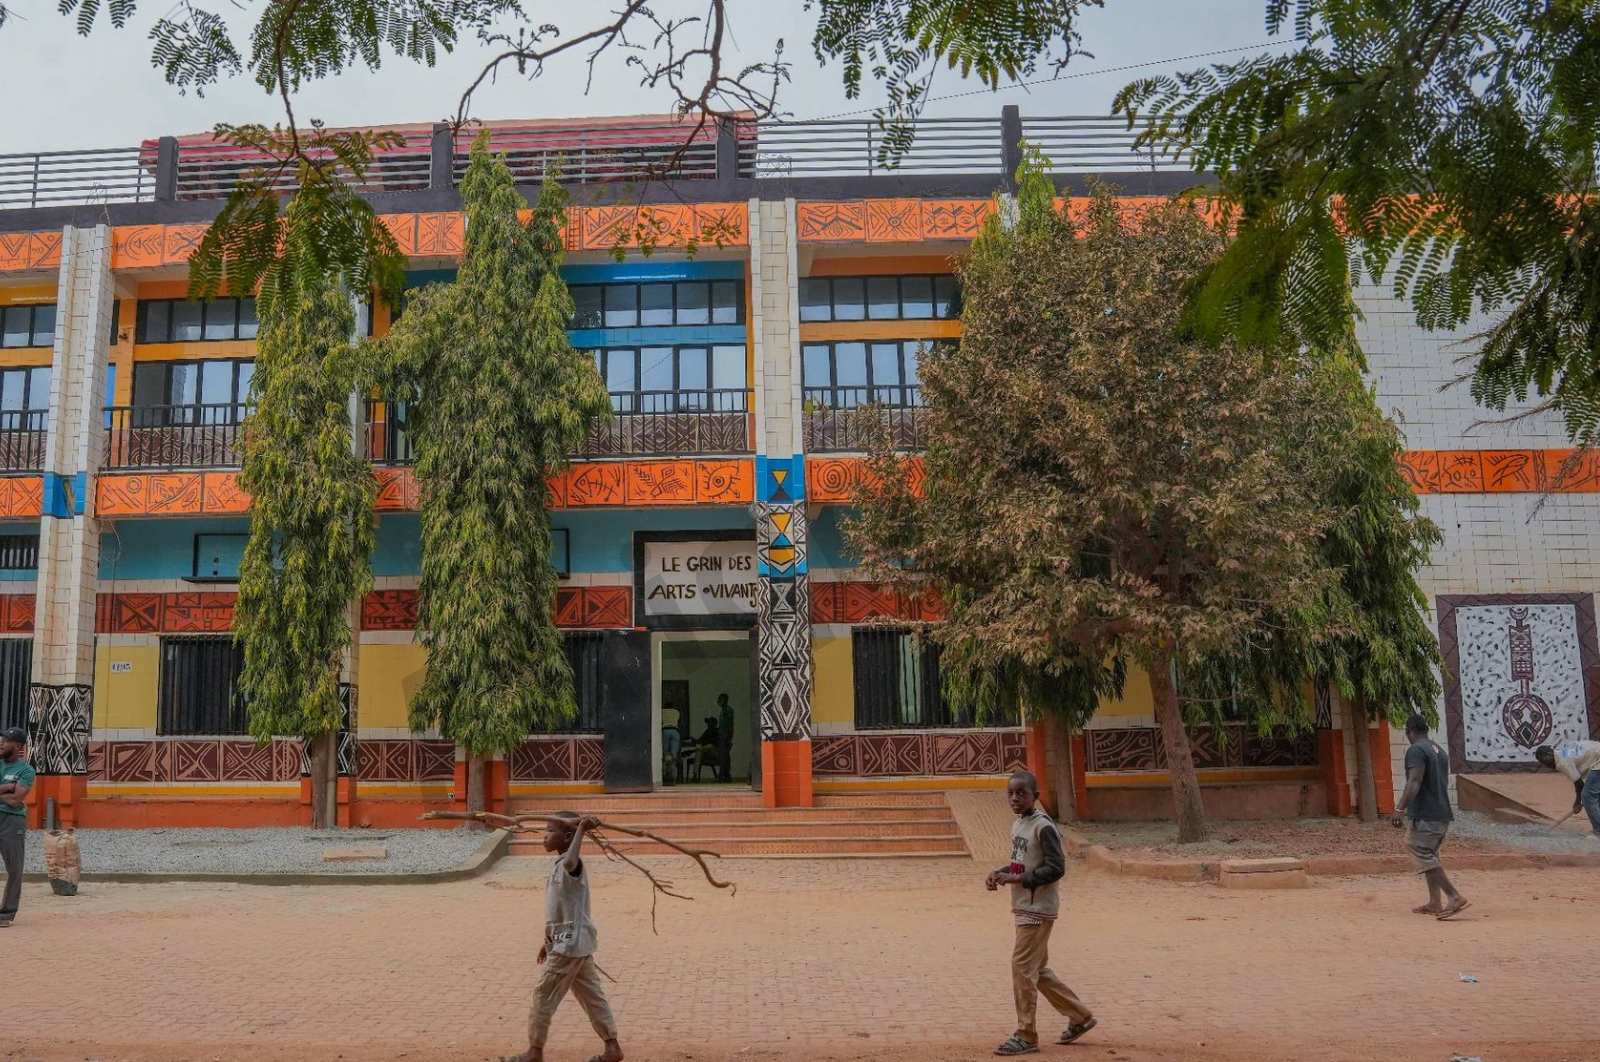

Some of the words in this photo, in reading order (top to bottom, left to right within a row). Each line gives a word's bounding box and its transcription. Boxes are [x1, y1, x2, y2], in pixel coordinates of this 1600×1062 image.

[662, 557, 681, 572] LE
[687, 556, 722, 571] GRIN
[728, 556, 752, 571] DES
[648, 584, 696, 599] ARTS
